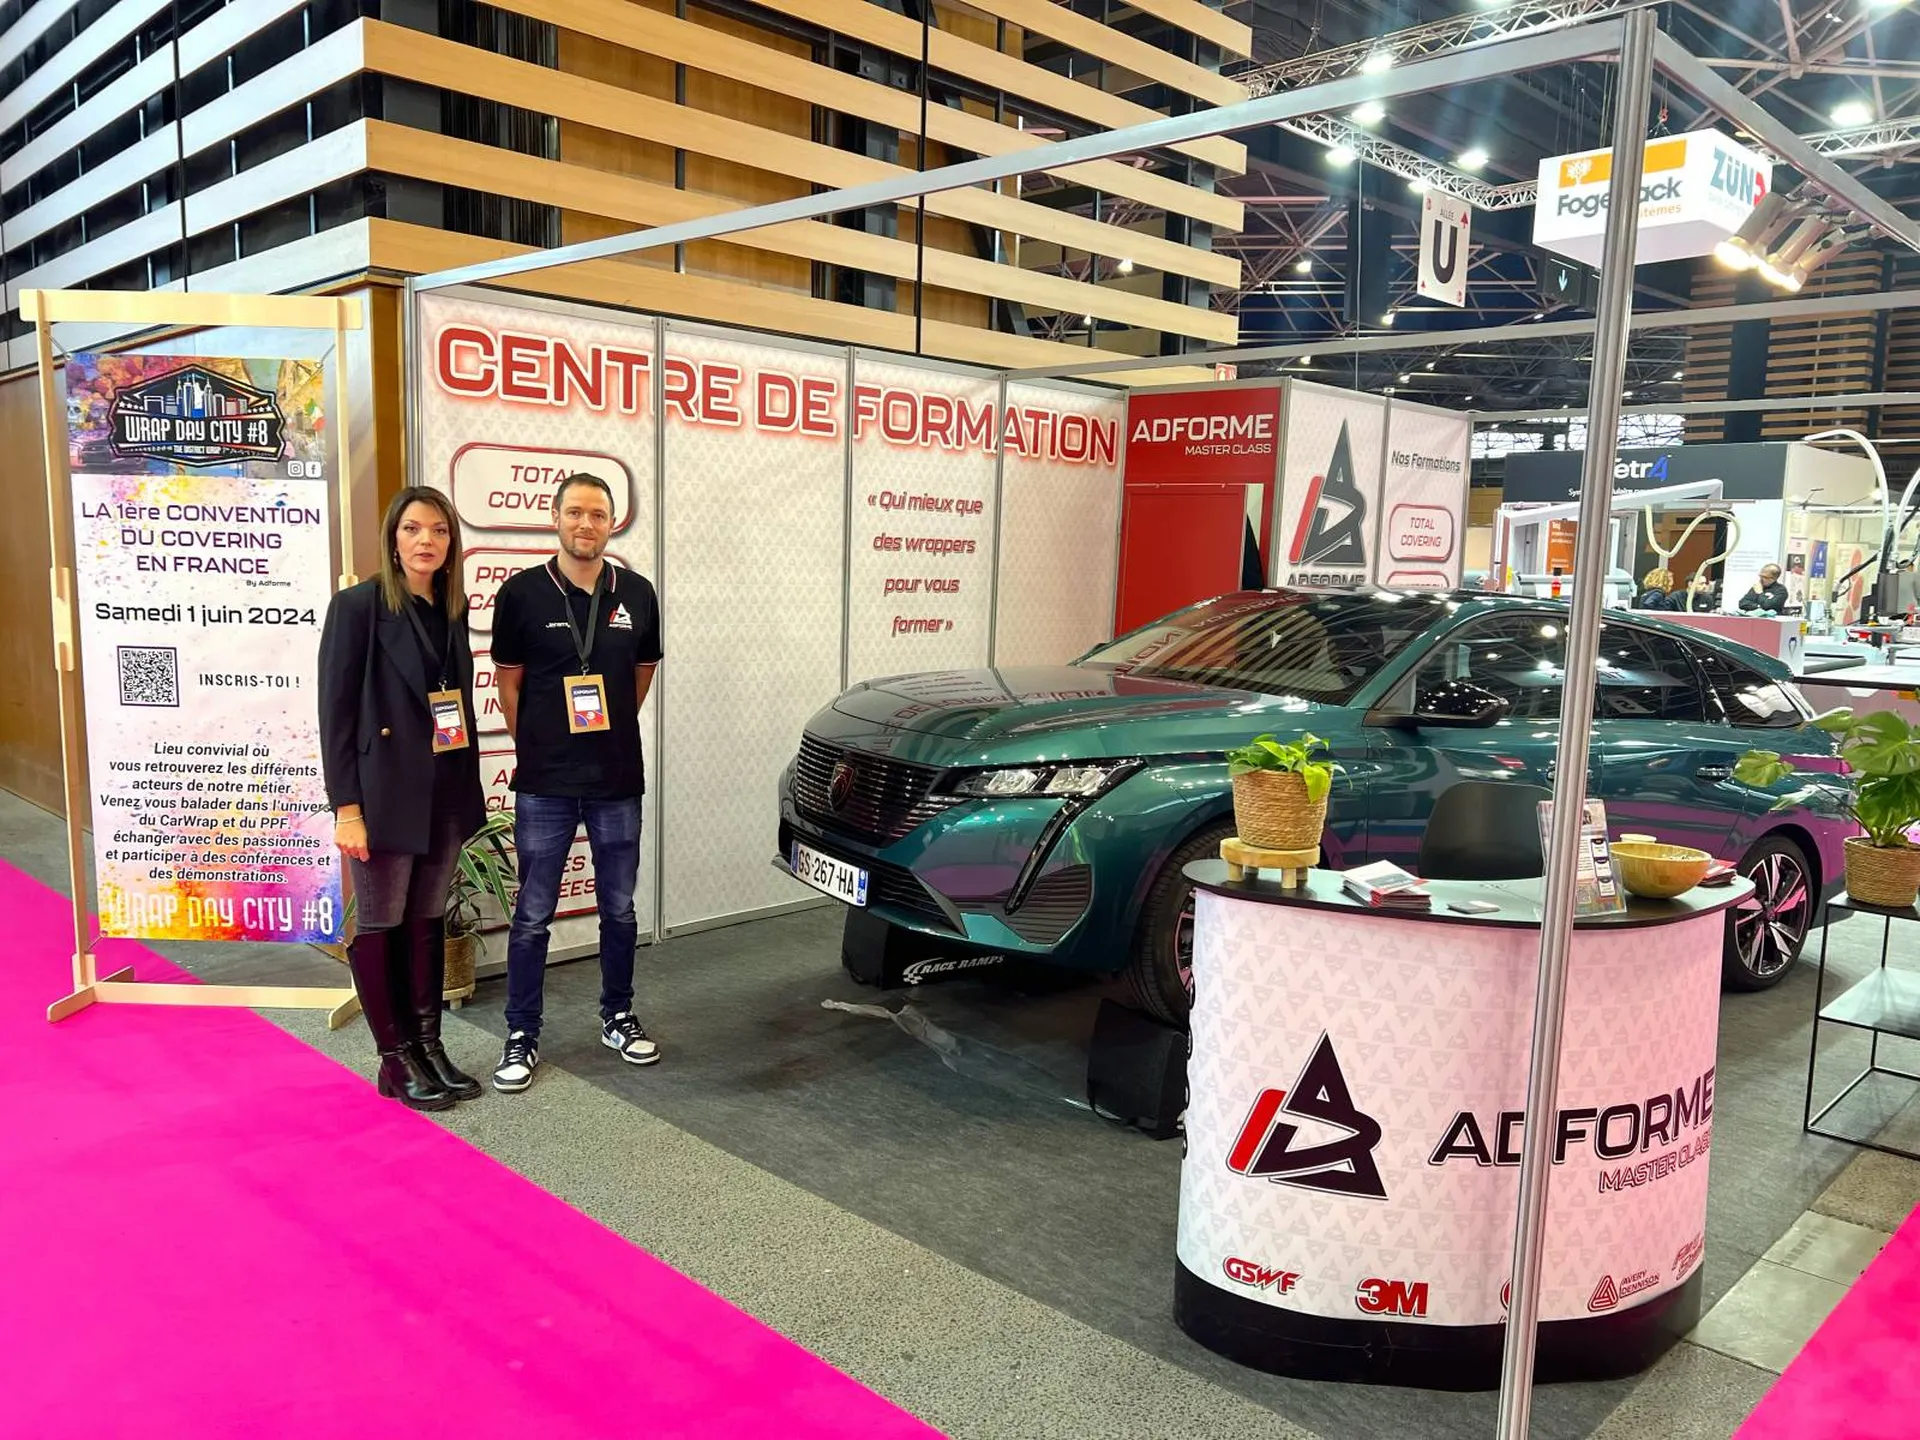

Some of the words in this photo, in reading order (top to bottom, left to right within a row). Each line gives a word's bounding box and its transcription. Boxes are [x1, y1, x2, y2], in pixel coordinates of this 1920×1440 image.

[1556, 176, 1684, 219] Fogeack
[1432, 219, 1458, 284] U
[437, 326, 740, 424] CENTRE
[756, 371, 836, 434] DE
[852, 384, 1117, 465] FORMATION
[124, 415, 171, 442] WRAP
[175, 418, 205, 442] DAY
[210, 417, 242, 444] CITY
[247, 419, 269, 446] #8
[1131, 413, 1274, 443] ADFORME
[1184, 444, 1230, 456] MASTER
[1231, 443, 1272, 455] CLASS
[1391, 450, 1410, 467] Nos
[1411, 453, 1461, 473] Formations
[488, 490, 558, 511] COVE
[880, 490, 907, 511] Qui
[908, 492, 953, 513] mieux
[955, 498, 983, 517] que
[82, 502, 112, 519] LA
[117, 503, 160, 521] 1ère
[167, 504, 320, 524] CONVENTION
[1410, 517, 1435, 530] TOTAL
[121, 529, 154, 546] DU
[161, 530, 282, 549] COVERING
[873, 532, 903, 552] des
[905, 537, 977, 557] wrappers
[1400, 534, 1442, 547] COVERING
[137, 555, 167, 572] EN
[173, 556, 269, 574] FRANCE
[246, 579, 257, 588] By
[258, 580, 292, 588] Adforme
[883, 577, 921, 597] pour
[924, 578, 960, 593] vous
[95, 602, 181, 623] Samedi
[187, 605, 195, 622] 1
[201, 604, 243, 627] juin
[248, 607, 316, 625] 2024
[892, 615, 944, 638] former
[199, 674, 290, 688] INSCRIS-TOI
[154, 741, 183, 755] Lieu
[187, 743, 249, 757] convivial
[252, 745, 270, 757] où
[109, 761, 141, 772] vous
[144, 761, 223, 774] retrouverez
[227, 762, 247, 775] les
[251, 763, 317, 776] différents
[132, 780, 183, 791] acteurs
[187, 779, 204, 792] de
[207, 781, 243, 793] notre
[247, 781, 295, 794] métier.
[100, 794, 141, 808] Venez
[144, 798, 177, 809] vous
[180, 797, 232, 810] balader
[235, 798, 269, 811] dans
[139, 813, 156, 826] du
[159, 814, 219, 830] CarWrap
[222, 817, 236, 828] et
[239, 816, 257, 829] du
[113, 830, 176, 847] échanger
[179, 835, 211, 845] avec
[214, 833, 239, 846] des
[242, 835, 320, 849] passionnés
[105, 849, 118, 860] et
[121, 849, 187, 864] participer
[190, 850, 199, 862] à
[202, 851, 230, 863] des
[230, 852, 313, 866] conférences
[317, 855, 331, 866] et
[149, 866, 173, 879] des
[176, 867, 287, 883] démonstrations.
[110, 890, 179, 930] WRAP
[188, 897, 234, 928] DAY
[243, 897, 293, 932] CITY
[302, 896, 334, 936] #8
[920, 960, 955, 974] RACE
[957, 954, 1006, 970] RAMPS
[1599, 1151, 1678, 1194] MASTER
[1223, 1256, 1304, 1295] GSWF
[1621, 1274, 1661, 1296] DENNISON
[1622, 1270, 1648, 1286] AVERY
[1356, 1277, 1429, 1318] 3M
